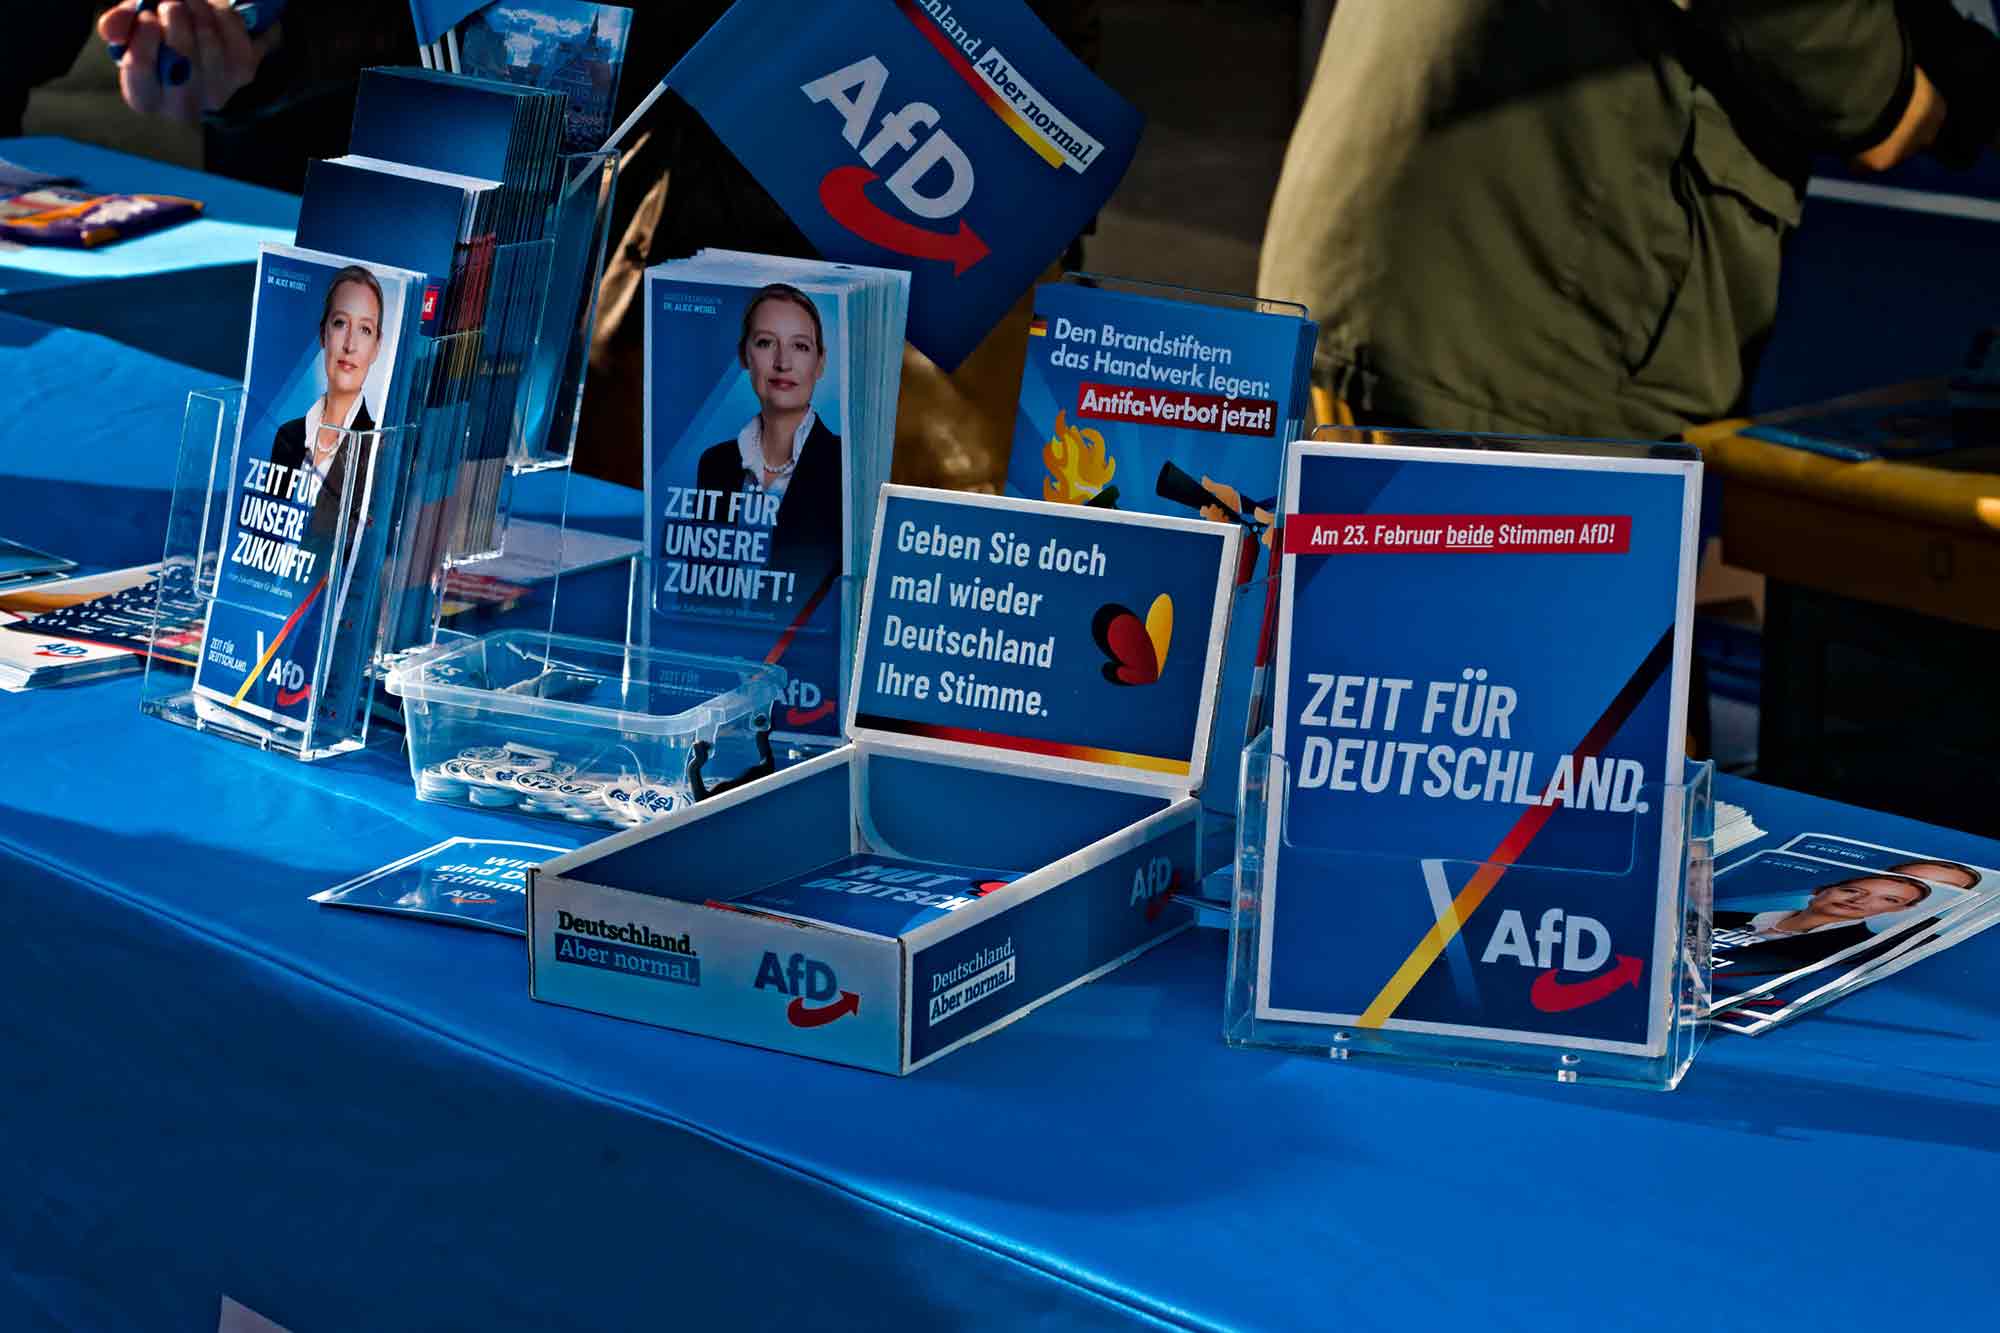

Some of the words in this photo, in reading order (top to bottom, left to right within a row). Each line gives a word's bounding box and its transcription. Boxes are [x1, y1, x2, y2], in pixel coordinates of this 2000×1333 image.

[919, 0, 981, 60] hland.
[979, 57, 1027, 104] Aber
[1022, 100, 1093, 165] normal.
[800, 55, 975, 219] AfD
[1054, 317, 1096, 343] Den
[1101, 324, 1232, 365] Brandstiftern
[1050, 345, 1089, 370] das
[1093, 349, 1204, 388] Handwerk
[1208, 366, 1270, 400] legen:
[1080, 389, 1219, 424] Antifa-Verbot
[1220, 401, 1271, 431] jetzt!
[243, 458, 288, 495] ZEIT
[286, 463, 322, 507] FÜR
[664, 486, 723, 520] ZEIT
[727, 483, 780, 526] FÜR
[240, 495, 309, 541] UNSERE
[1311, 525, 1338, 546] Am
[1343, 526, 1369, 545] 23.
[1374, 525, 1443, 545] Februar
[1446, 524, 1494, 547] beide
[1498, 524, 1574, 545] Stimmen
[1579, 523, 1616, 544] AfD!
[231, 532, 316, 584] ZUKUNFT!
[665, 524, 769, 563] UNSERE
[897, 520, 981, 561] Geben
[989, 532, 1031, 566] Sie
[1039, 539, 1106, 576] doch
[663, 562, 795, 603] ZUKUNFT!
[890, 572, 942, 605] mal
[950, 577, 1043, 617] wieder
[883, 614, 1055, 669] Deutschland
[266, 658, 304, 690] AfD
[774, 679, 821, 708] AfD
[876, 662, 930, 699] Ihre
[938, 671, 1049, 717] Stimme.
[1300, 673, 1413, 731] ZEIT
[1421, 667, 1517, 739] FÜR
[1297, 735, 1650, 814] DEUTSCHLAND.
[435, 863, 501, 875] sind
[1130, 856, 1172, 906] AfD
[800, 878, 976, 911] DEUTSCH
[557, 910, 697, 957] Deutschland.
[1480, 909, 1612, 972] AfD
[559, 938, 609, 965] Aber
[614, 951, 698, 984] normal.
[753, 951, 837, 1001] AfD
[931, 937, 1015, 992] Deutschland.
[930, 986, 960, 1019] Aber
[963, 961, 1014, 1008] normal.
